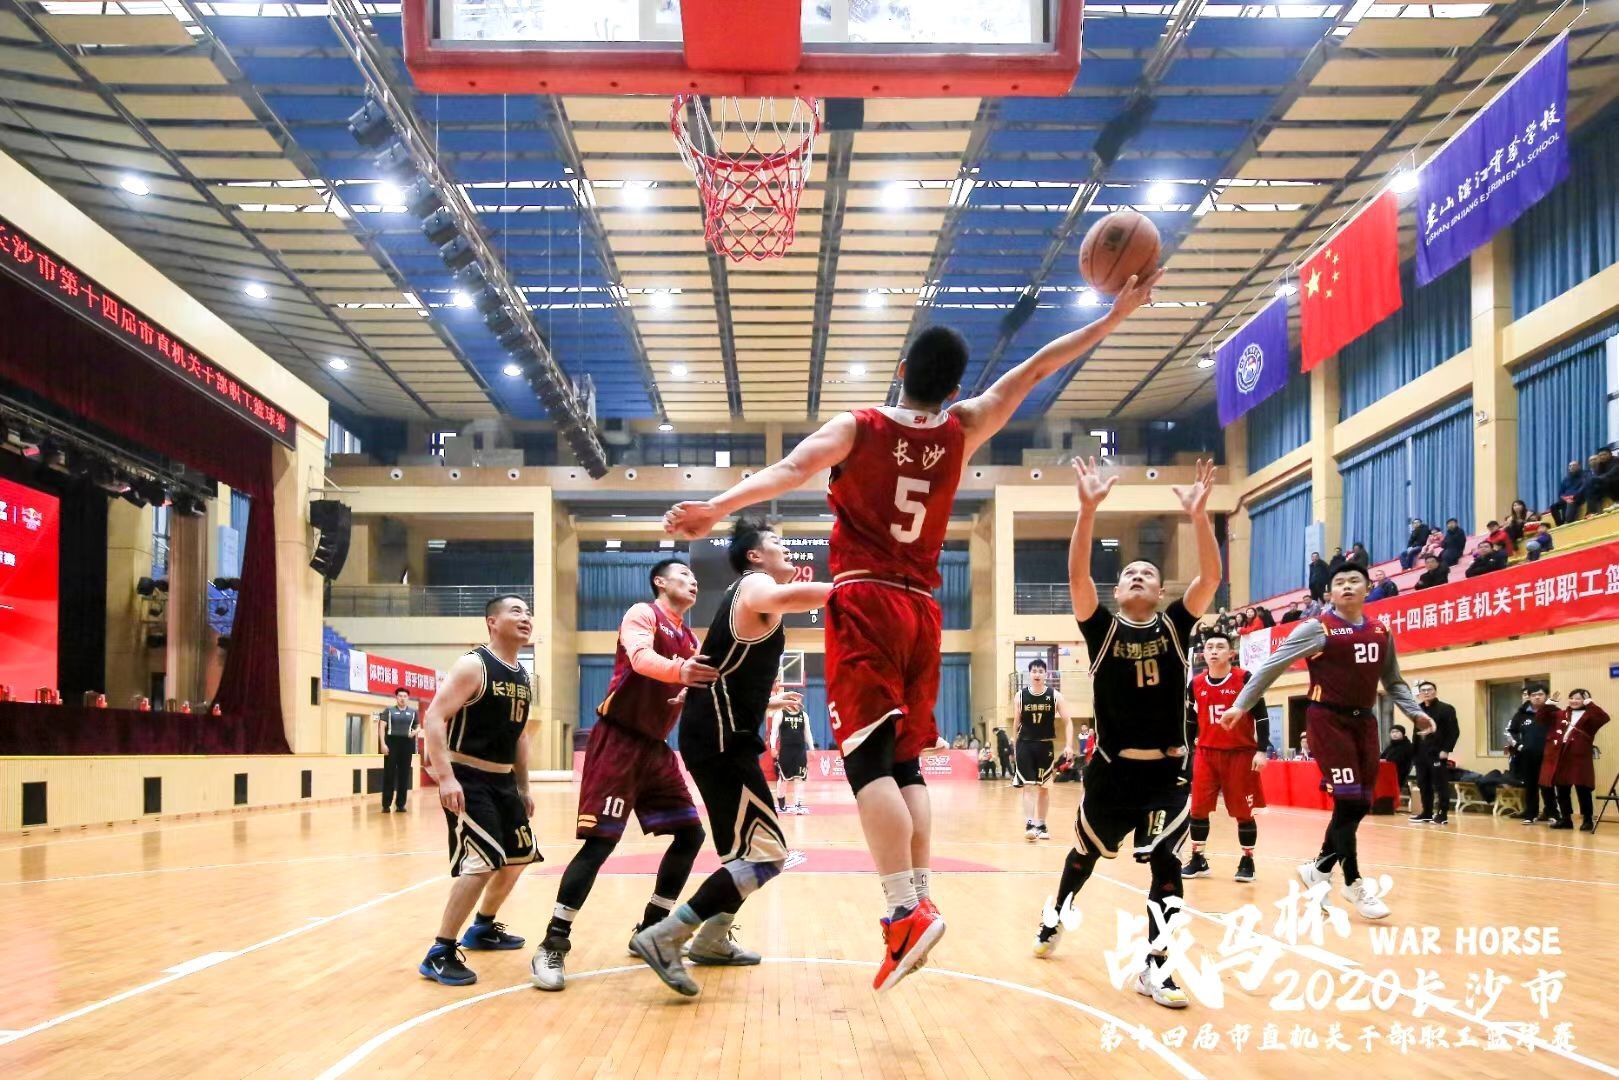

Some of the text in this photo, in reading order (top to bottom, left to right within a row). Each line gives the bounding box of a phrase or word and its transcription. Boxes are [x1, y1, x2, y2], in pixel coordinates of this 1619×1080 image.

[1528, 132, 1560, 163] SCHOOL
[893, 438, 946, 471] 长沙
[890, 476, 931, 544] 5
[791, 566, 813, 582] 29
[1354, 643, 1379, 664] 20
[1135, 658, 1160, 688] 19
[511, 697, 525, 722] 16
[828, 701, 841, 730] 5
[1032, 713, 1042, 724] 17
[1209, 704, 1226, 724] 15
[1331, 767, 1355, 785] 20
[602, 796, 625, 819] 10
[1148, 810, 1167, 836] 19
[515, 826, 532, 849] 16
